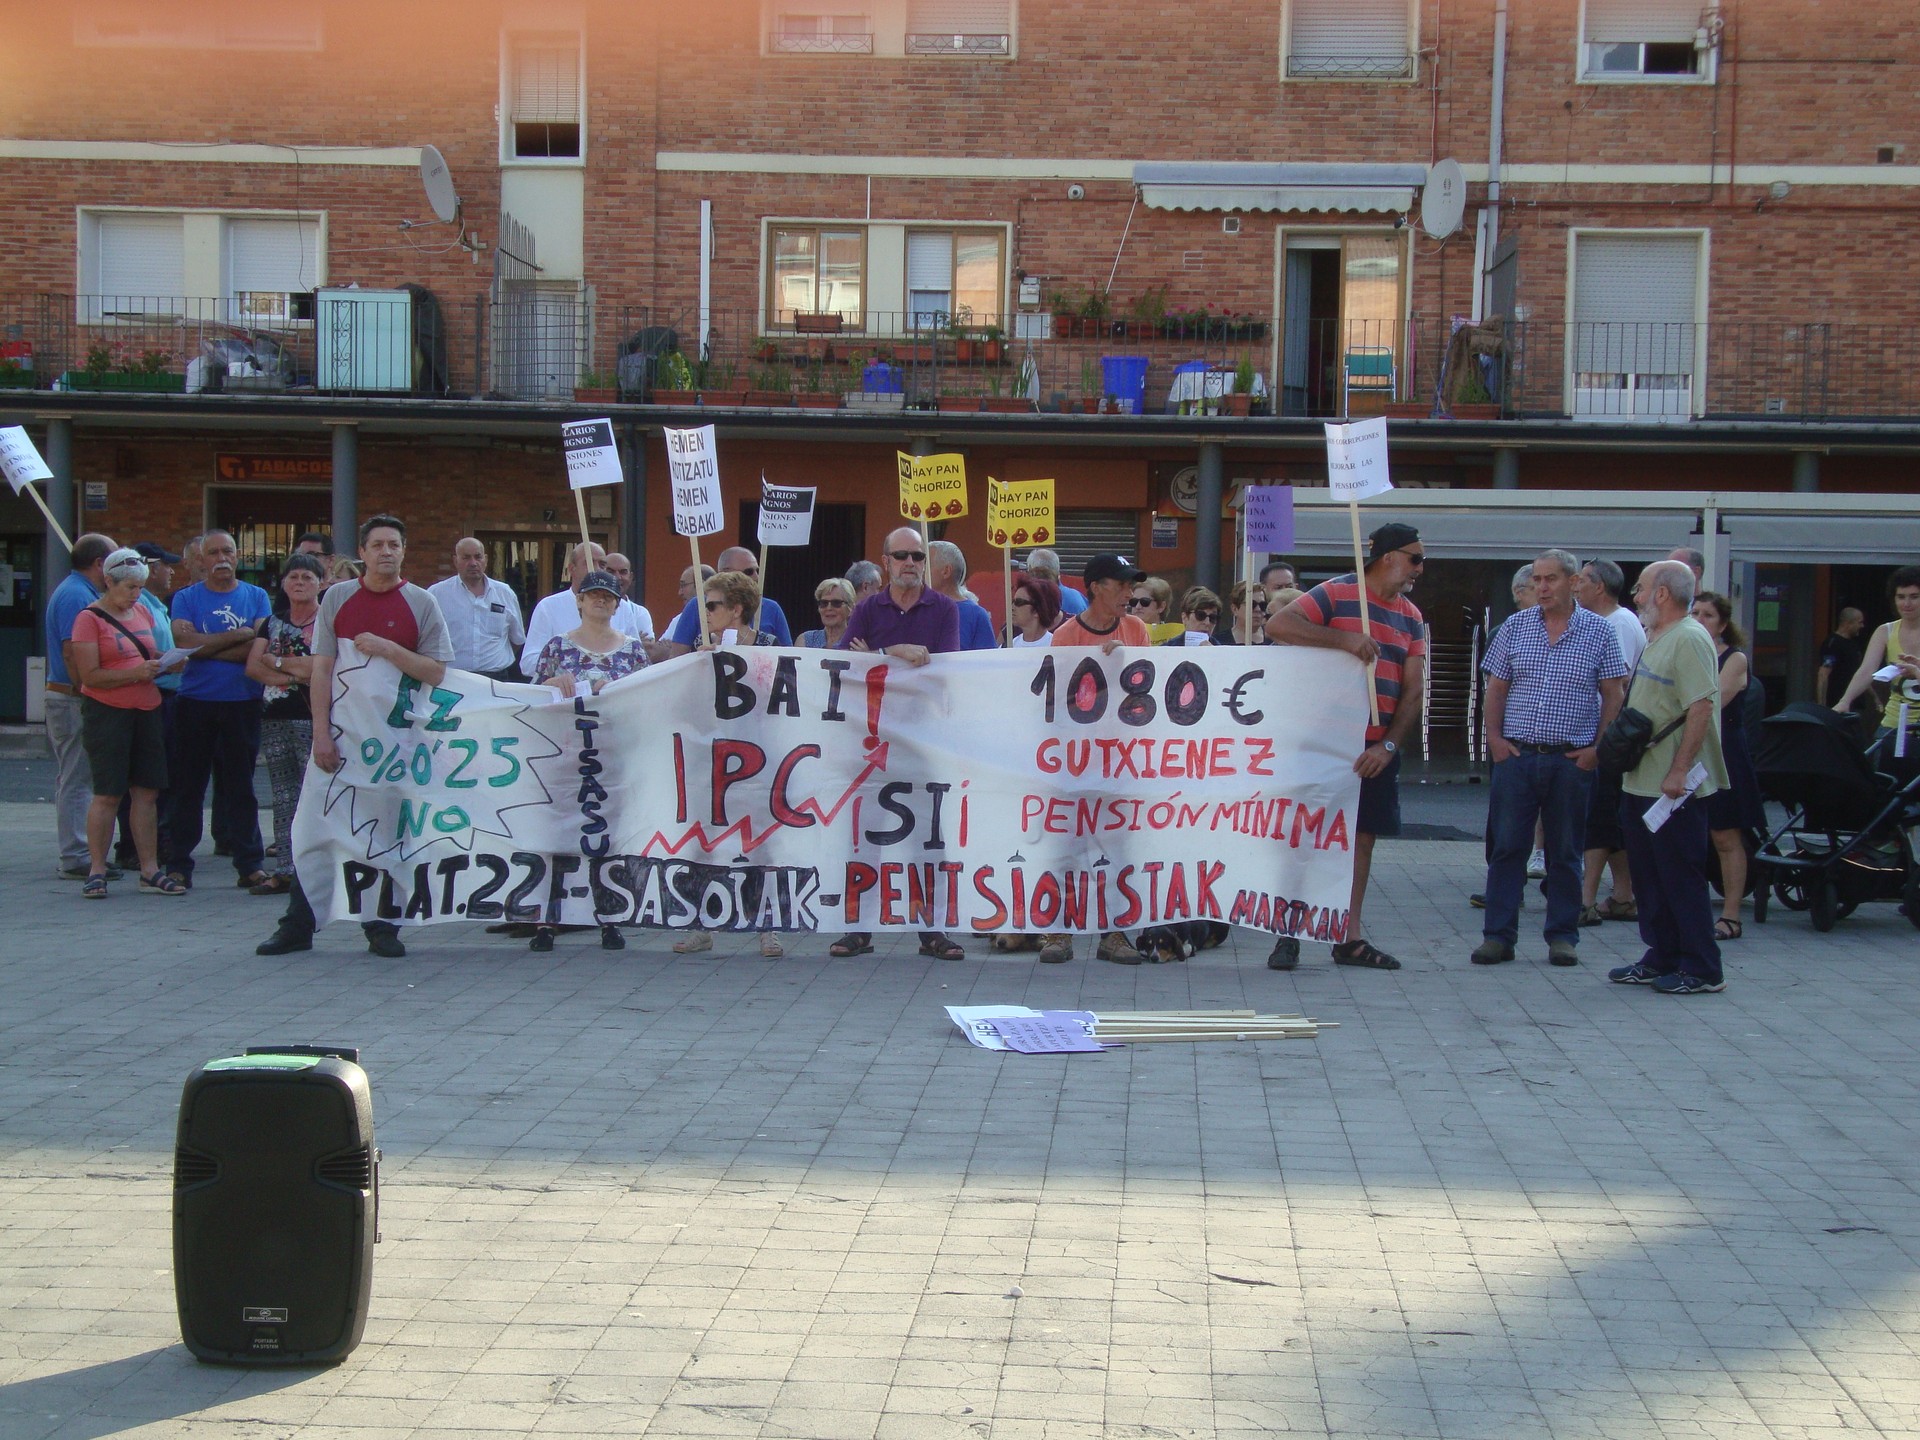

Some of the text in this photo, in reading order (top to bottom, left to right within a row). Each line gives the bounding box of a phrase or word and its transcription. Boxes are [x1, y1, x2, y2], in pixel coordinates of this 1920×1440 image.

[562, 425, 597, 437] LARIOS
[670, 431, 705, 454] HEMEN
[252, 459, 332, 474] TABACOS
[1361, 457, 1373, 467] LAS
[912, 466, 933, 477] HAY
[936, 464, 959, 475] PAN
[913, 479, 962, 493] CHORIZO
[1335, 479, 1369, 490] PENSIONES
[999, 492, 1022, 503] HAY
[1025, 490, 1048, 502] PAN
[1245, 494, 1272, 503] DATA
[545, 510, 553, 521] 7
[999, 506, 1050, 519] CHORIZO
[676, 511, 717, 535] ERABAKI
[387, 671, 465, 732] EZ
[1035, 737, 1276, 780] GUTXIENEZ
[573, 690, 611, 857] LTSASU
[672, 732, 822, 828] IPC
[396, 798, 471, 840] NO
[1021, 790, 1208, 838] PENSIÓN
